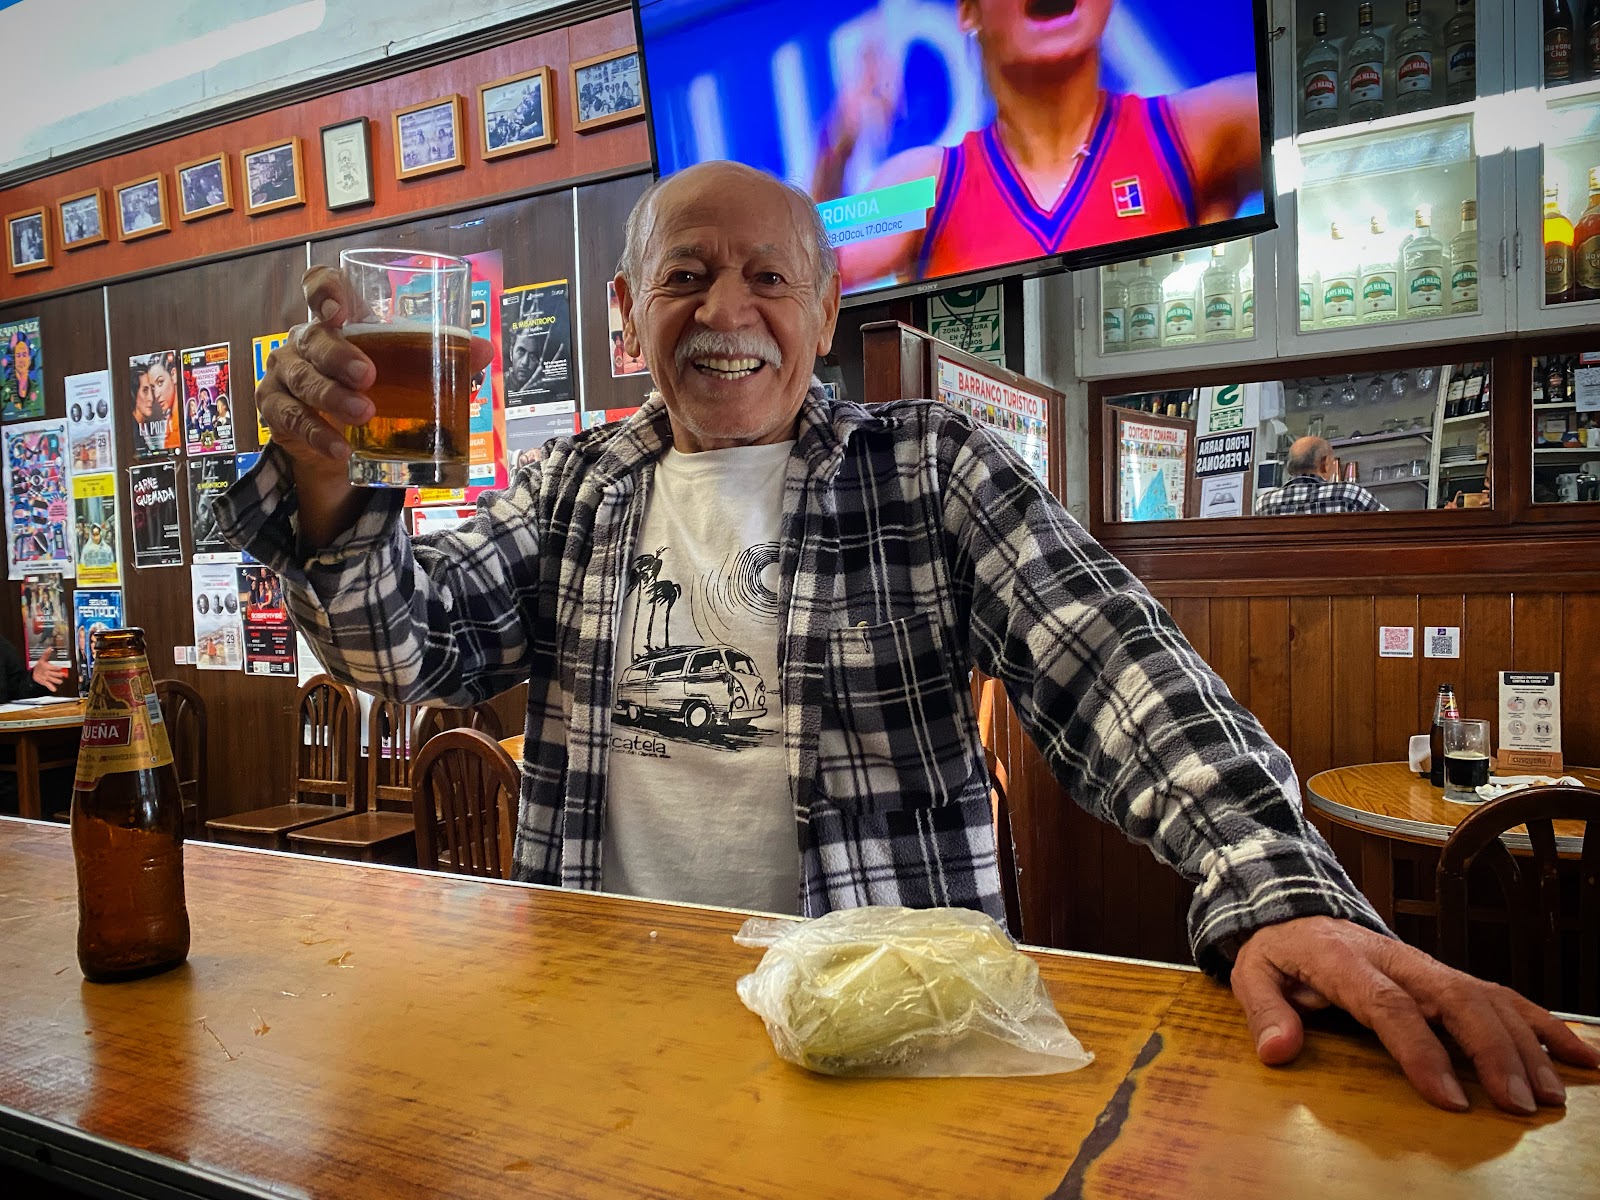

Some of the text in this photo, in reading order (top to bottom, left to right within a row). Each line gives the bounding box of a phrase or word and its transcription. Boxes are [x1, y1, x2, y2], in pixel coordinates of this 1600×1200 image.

[823, 197, 880, 225] RONDA
[917, 283, 938, 292] SONY
[961, 323, 989, 332] SGURA
[958, 371, 1038, 416] BARRANCO TURÍSTICO
[134, 476, 159, 494] CARNE
[136, 486, 175, 507] QUEMADA
[226, 633, 235, 644] 29
